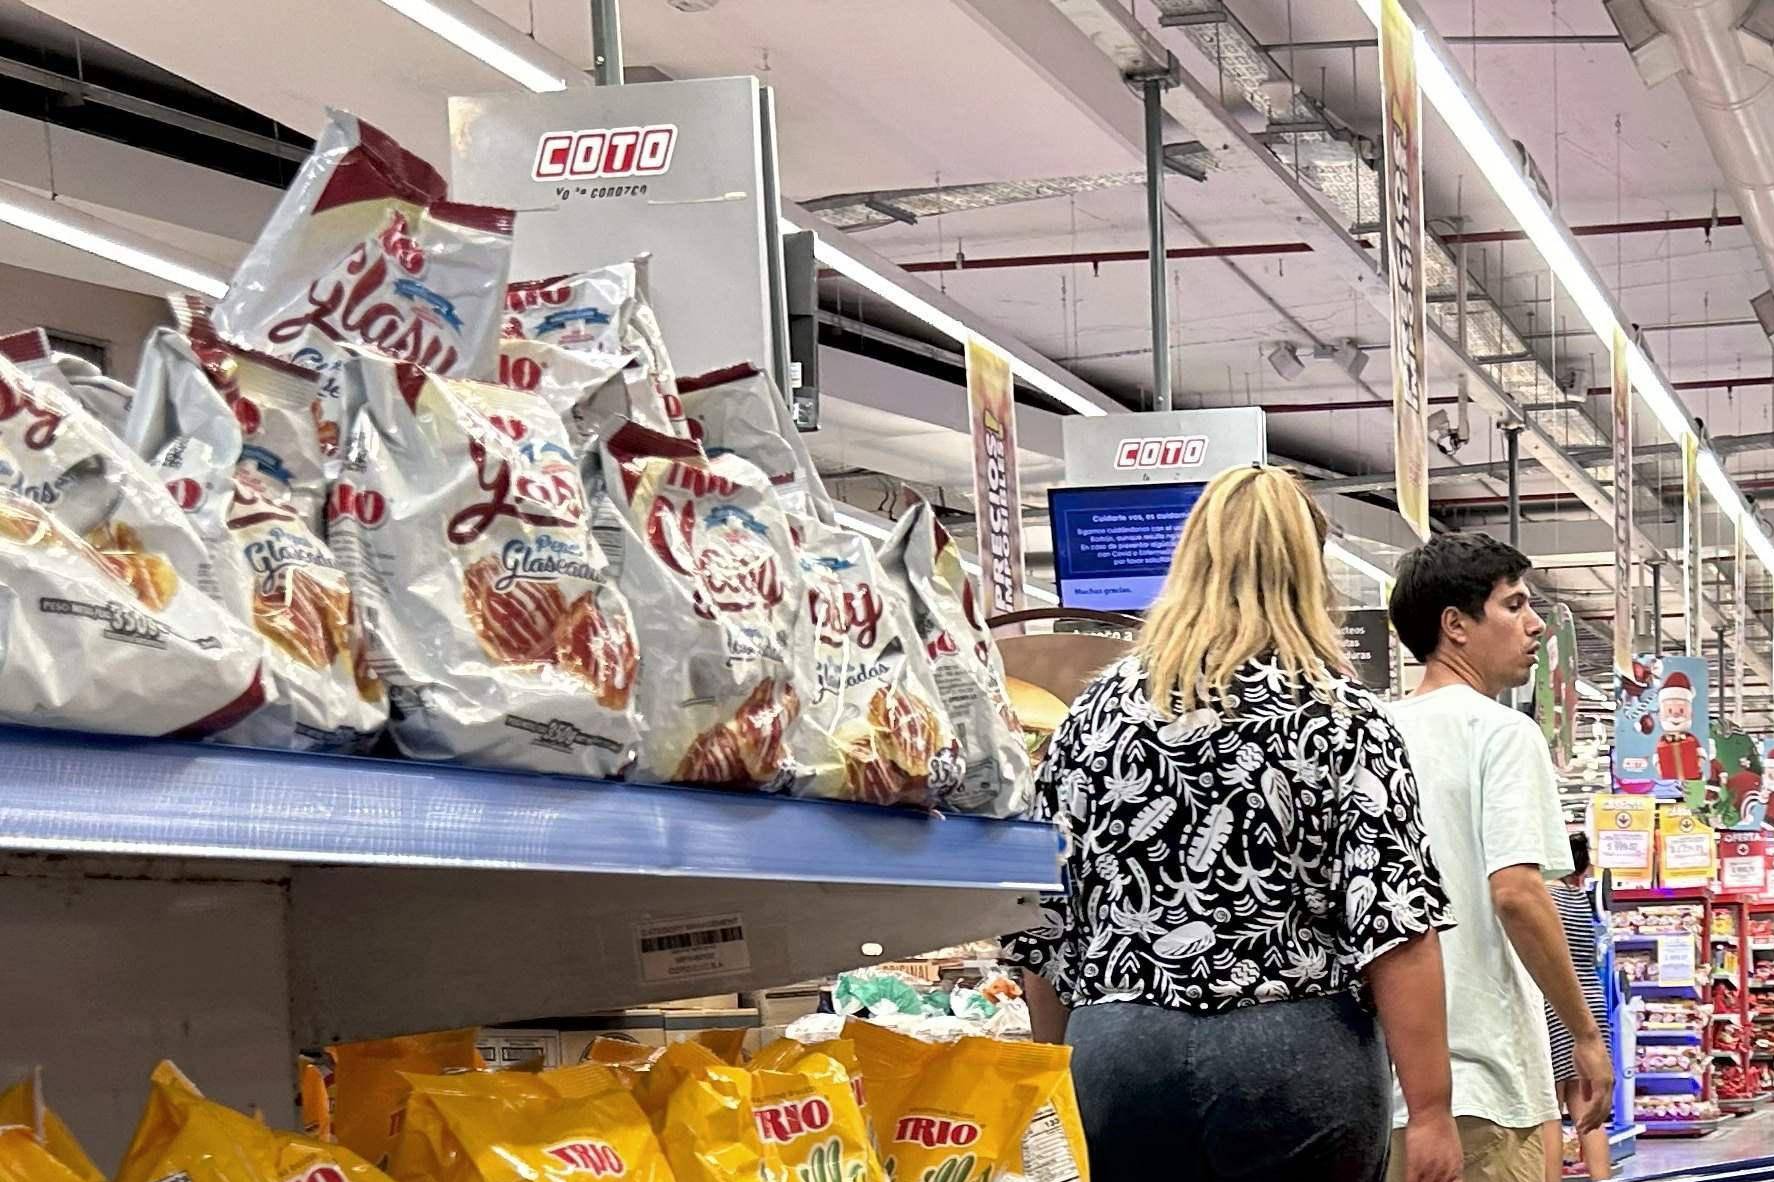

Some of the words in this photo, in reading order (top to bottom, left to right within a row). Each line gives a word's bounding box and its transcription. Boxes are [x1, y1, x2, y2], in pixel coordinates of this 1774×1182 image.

[534, 127, 675, 179] COTO
[1116, 438, 1207, 468] COTO
[984, 431, 1009, 611] PRECIOS
[896, 1117, 978, 1146] TRIO
